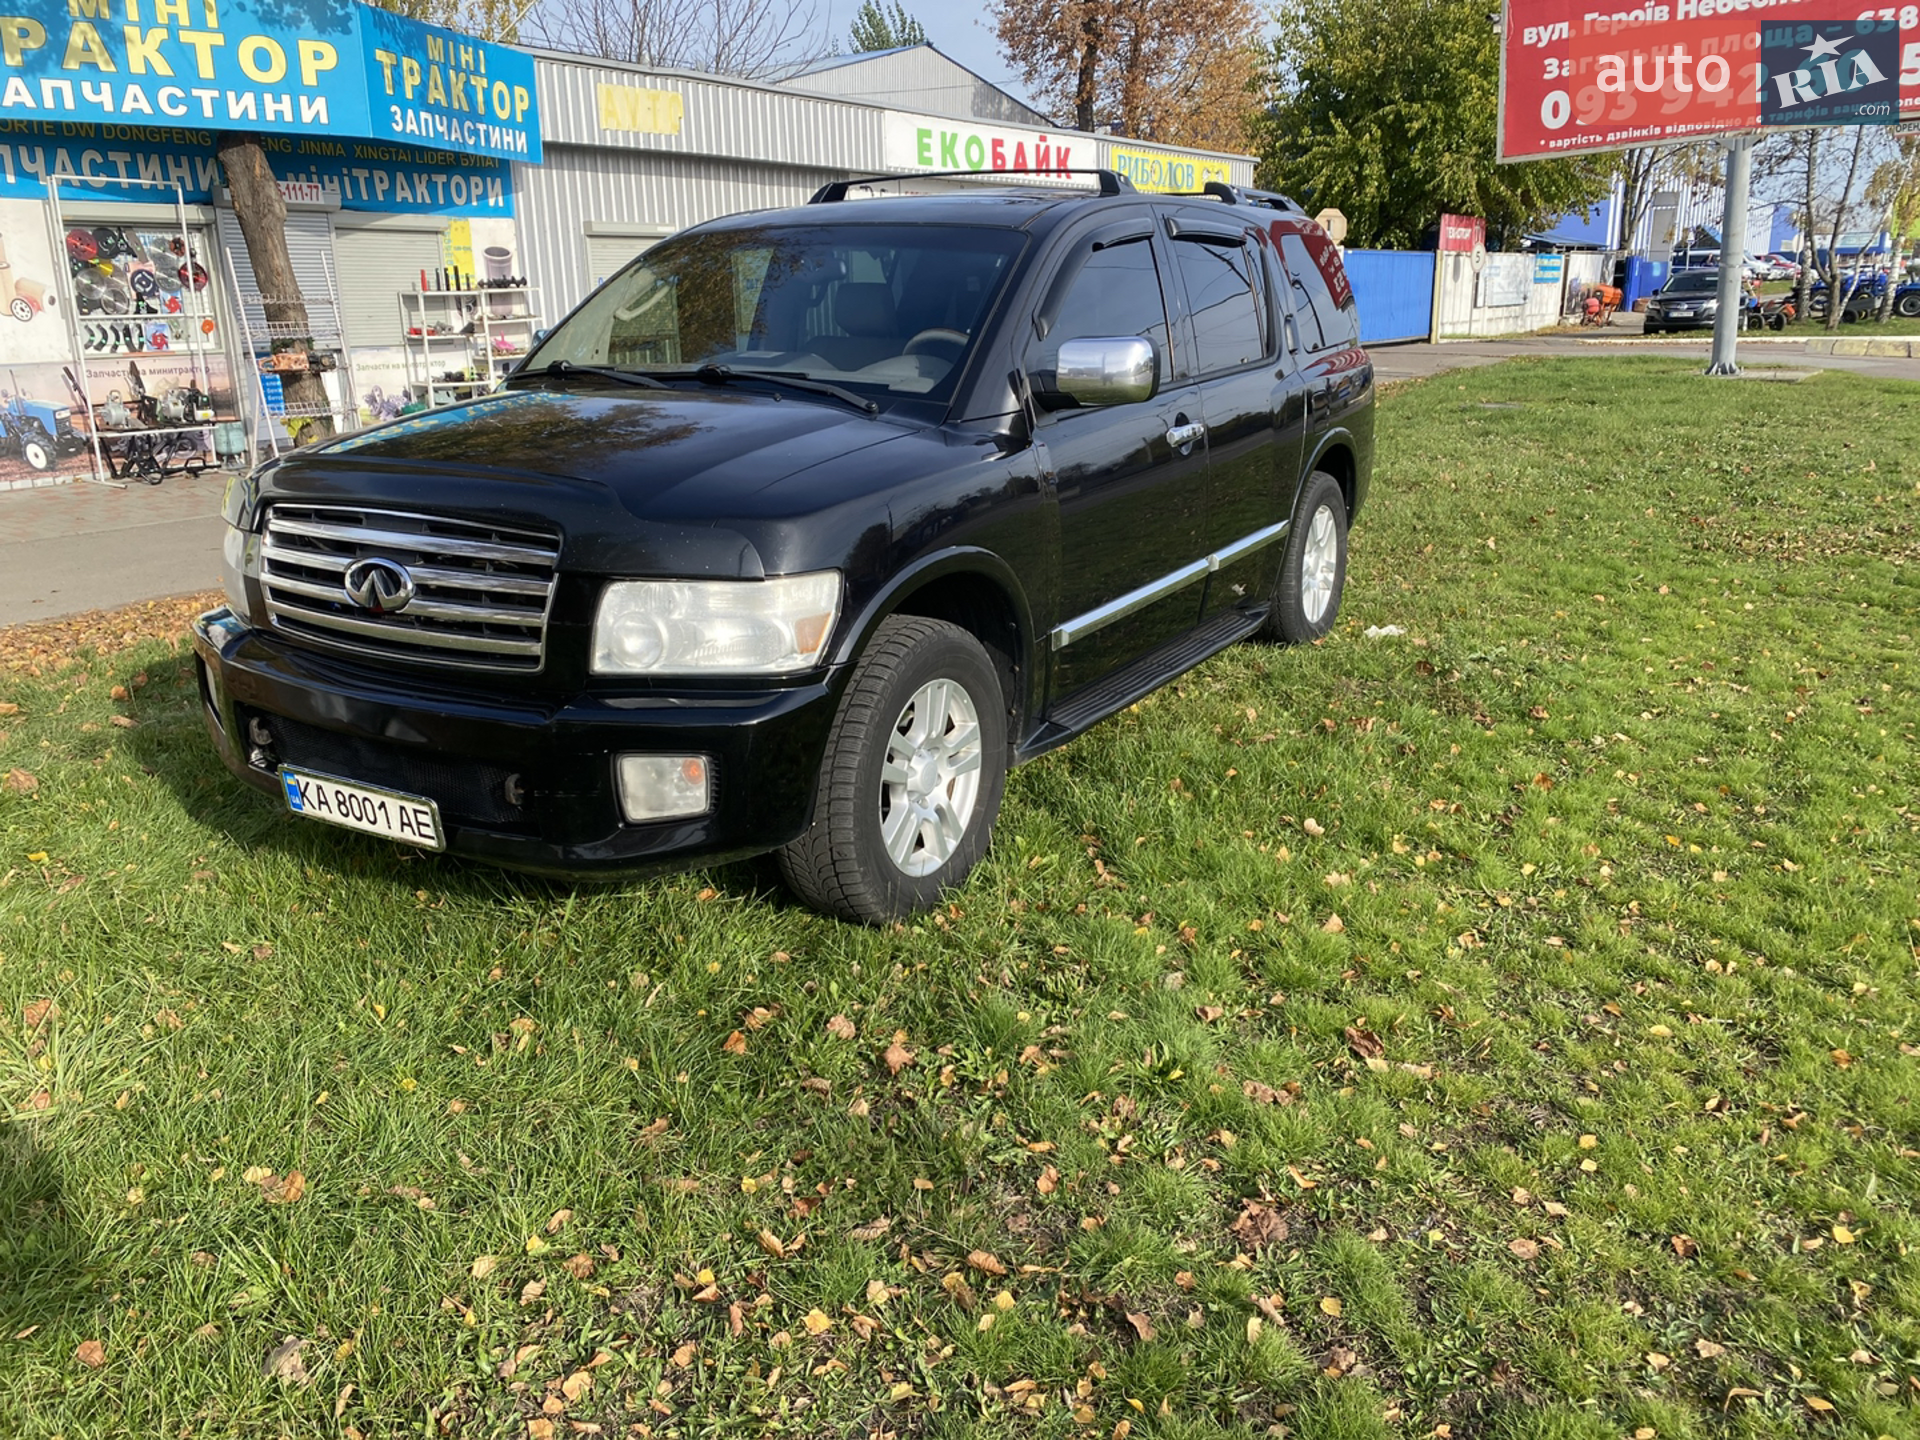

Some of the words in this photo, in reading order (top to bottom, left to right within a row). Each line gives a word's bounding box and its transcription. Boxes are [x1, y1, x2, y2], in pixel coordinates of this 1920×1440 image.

[1523, 21, 1577, 48] вул.
[1583, 2, 1670, 36] Героїв
[1701, 24, 1813, 57] площа
[1855, 5, 1919, 35] 638
[426, 34, 486, 74] МІНІ
[375, 48, 530, 123] ТРАКТОР
[1540, 79, 1638, 130] 093
[102, 123, 212, 146] DONGFENG
[297, 139, 347, 157] JINMA
[353, 144, 411, 163] XINGTAI
[415, 150, 457, 166] LIDER
[390, 105, 529, 154] ЗАПЧАСТИНИ
[1606, 124, 1662, 142] дзвінків
[916, 128, 1073, 180] ЕКОБАЙК
[1117, 154, 1195, 191] РИБОЛОВ
[1475, 250, 1482, 264] 5
[295, 778, 333, 814] KA
[335, 789, 392, 831] 8001
[399, 804, 436, 841] AE
